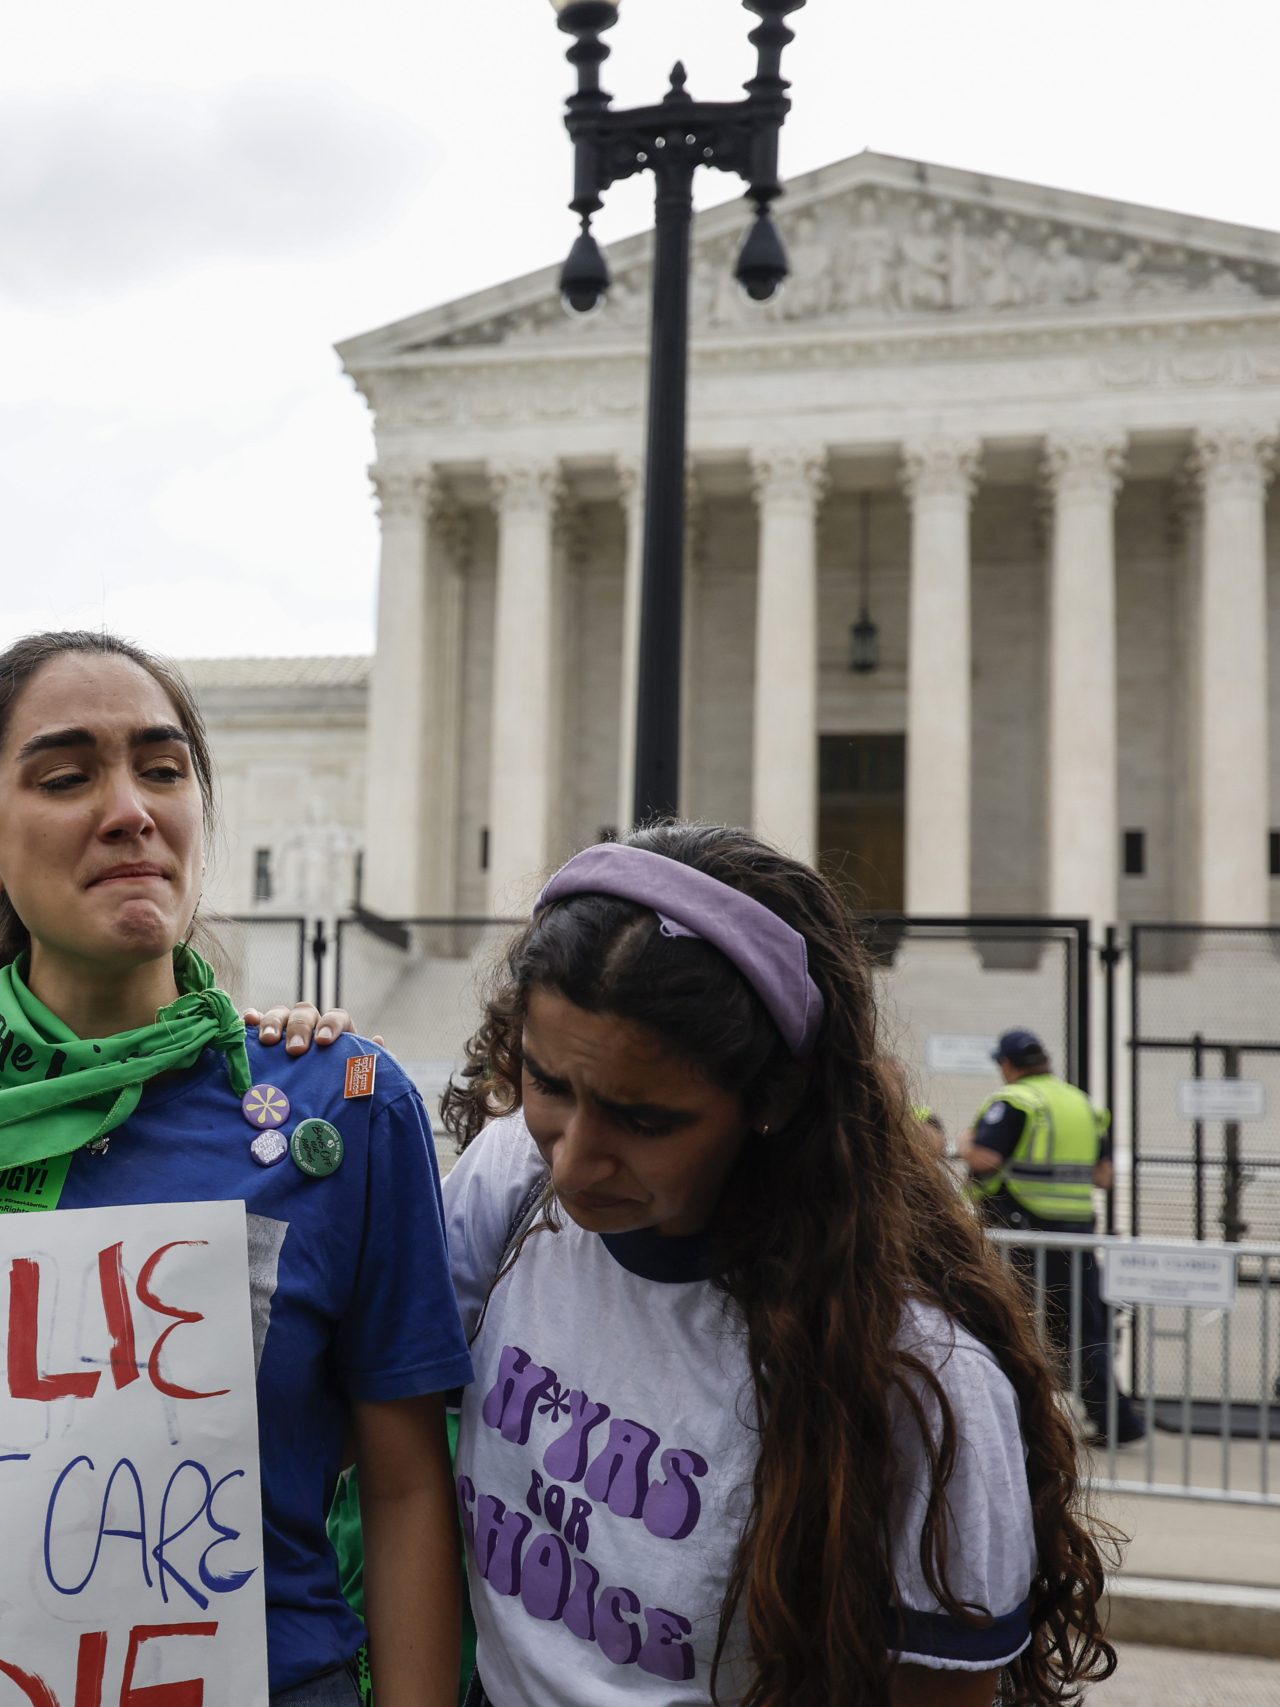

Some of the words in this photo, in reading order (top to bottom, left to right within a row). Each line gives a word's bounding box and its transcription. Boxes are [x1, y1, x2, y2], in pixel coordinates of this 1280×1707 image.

[8, 1240, 232, 1401] LIE
[43, 1453, 260, 1610] CARE
[457, 1474, 696, 1682] CHOICE
[525, 1468, 594, 1555] FOR
